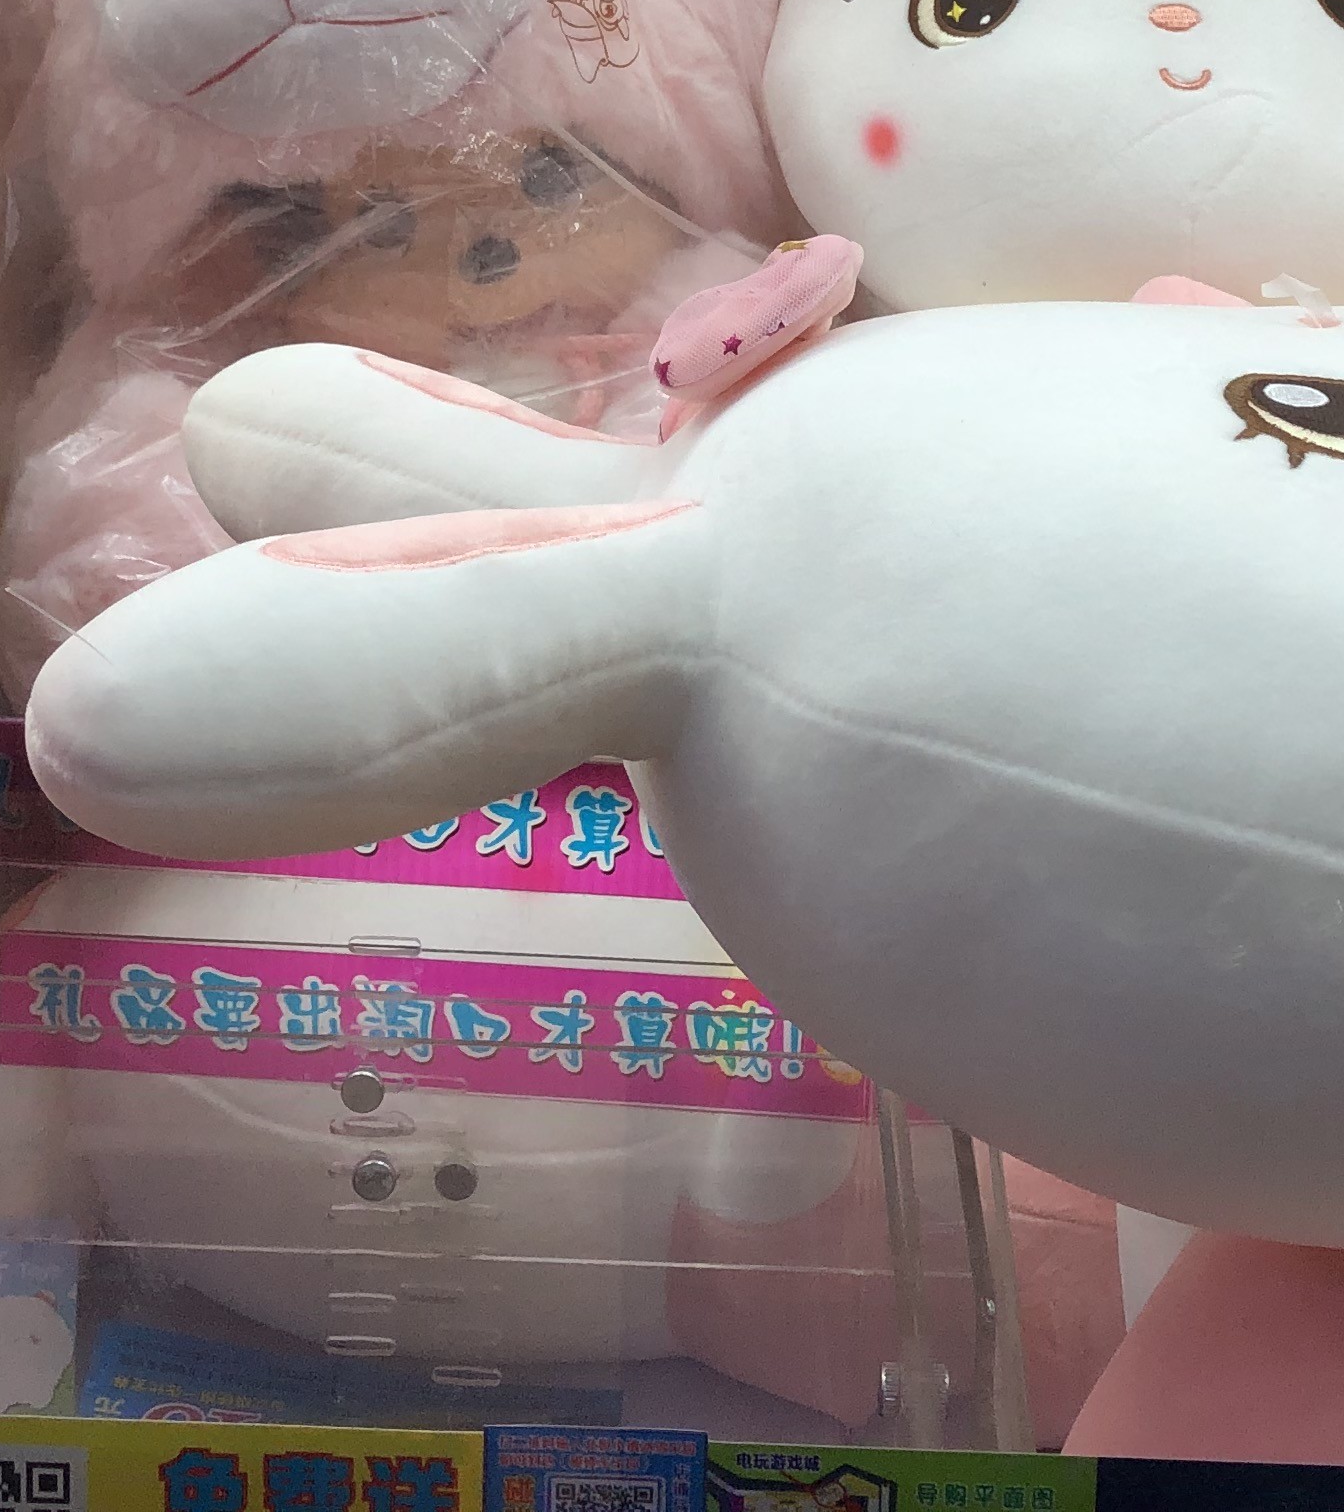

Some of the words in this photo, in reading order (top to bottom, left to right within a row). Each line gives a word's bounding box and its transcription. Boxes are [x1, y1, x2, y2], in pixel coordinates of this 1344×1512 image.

[735, 1452, 823, 1473] 电玩游戏城
[916, 1482, 1056, 1511] 导购平面图
